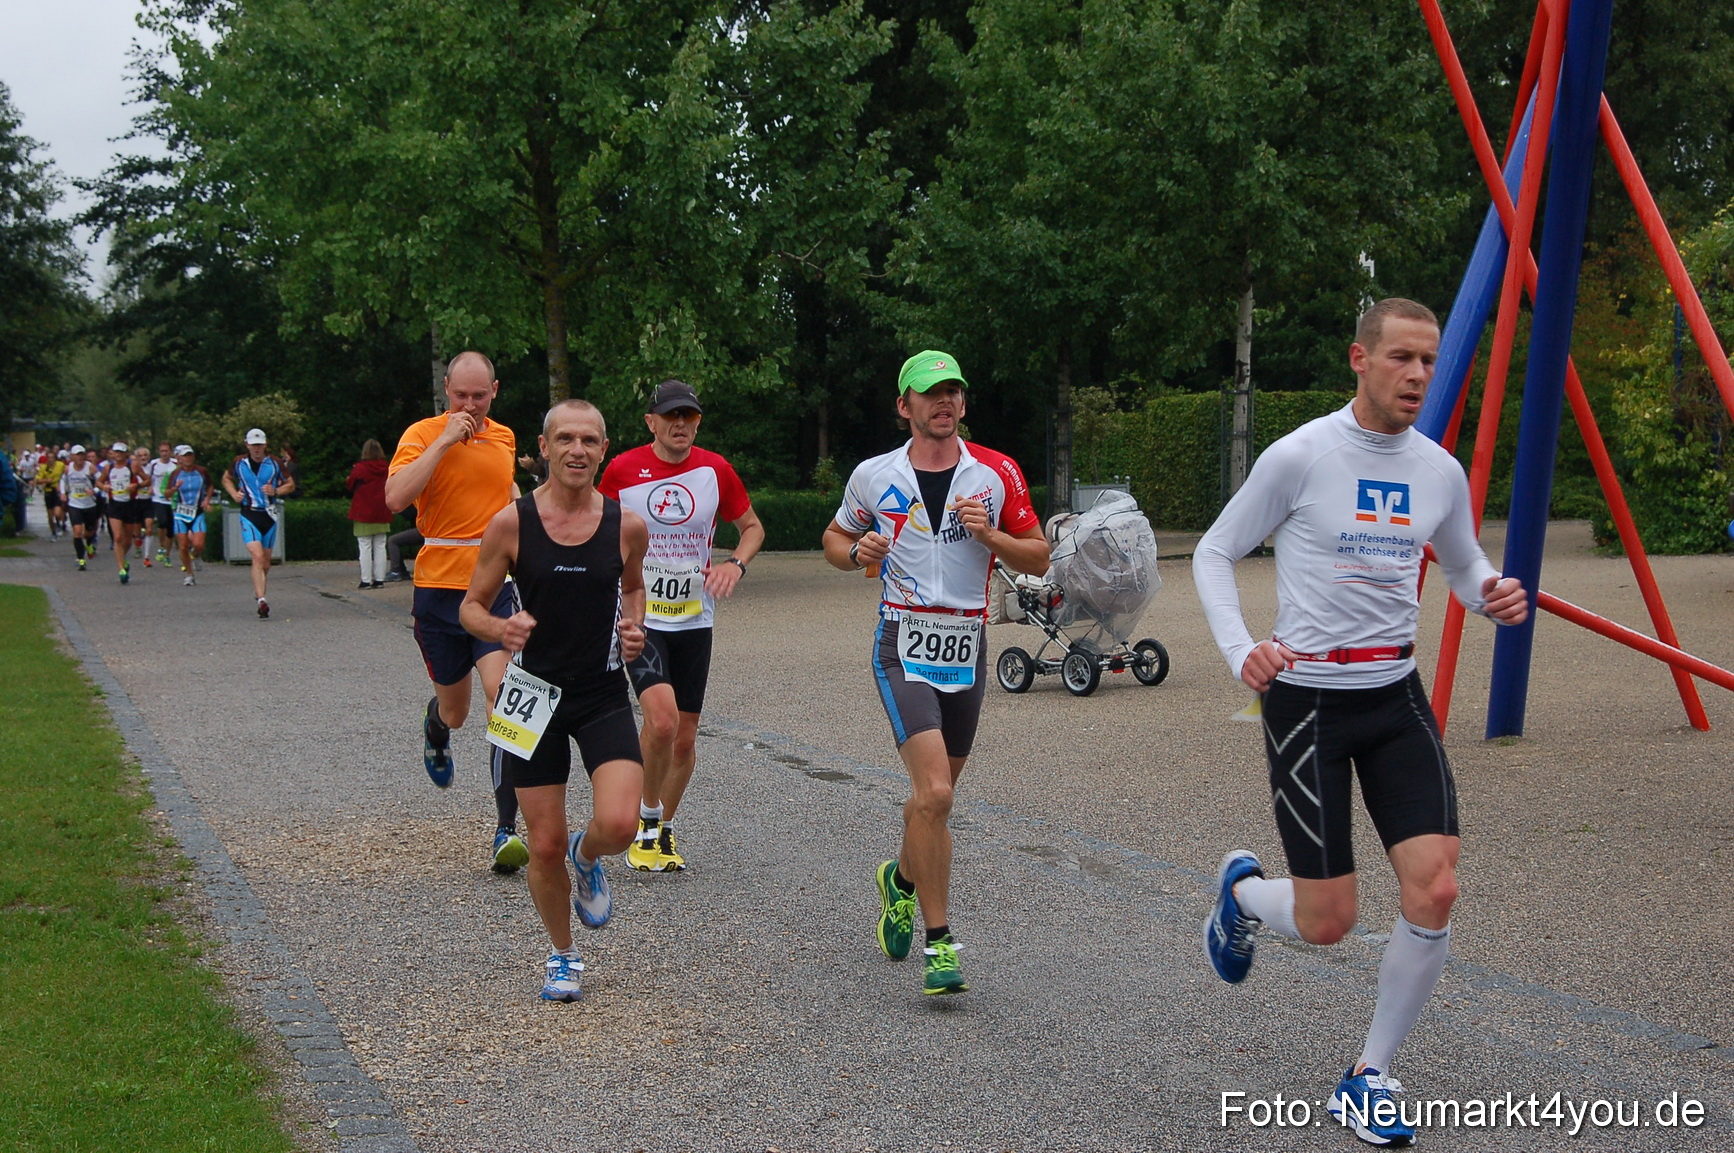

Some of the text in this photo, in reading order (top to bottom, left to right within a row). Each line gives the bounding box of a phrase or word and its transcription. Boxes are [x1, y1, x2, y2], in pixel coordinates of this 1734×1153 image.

[941, 513, 995, 544] TRIAN
[688, 532, 706, 540] HER
[1340, 532, 1416, 546] Raiffeisenbank
[646, 550, 699, 558] eistungsdiagnostik
[1337, 545, 1412, 558] am Rothsee eG
[664, 568, 692, 576] Neumarkt
[651, 577, 691, 600] 404
[652, 603, 686, 615] Michael
[902, 617, 969, 631] PARTL Neumarkt
[907, 630, 972, 663] 2986
[508, 673, 547, 695] Neumarkt
